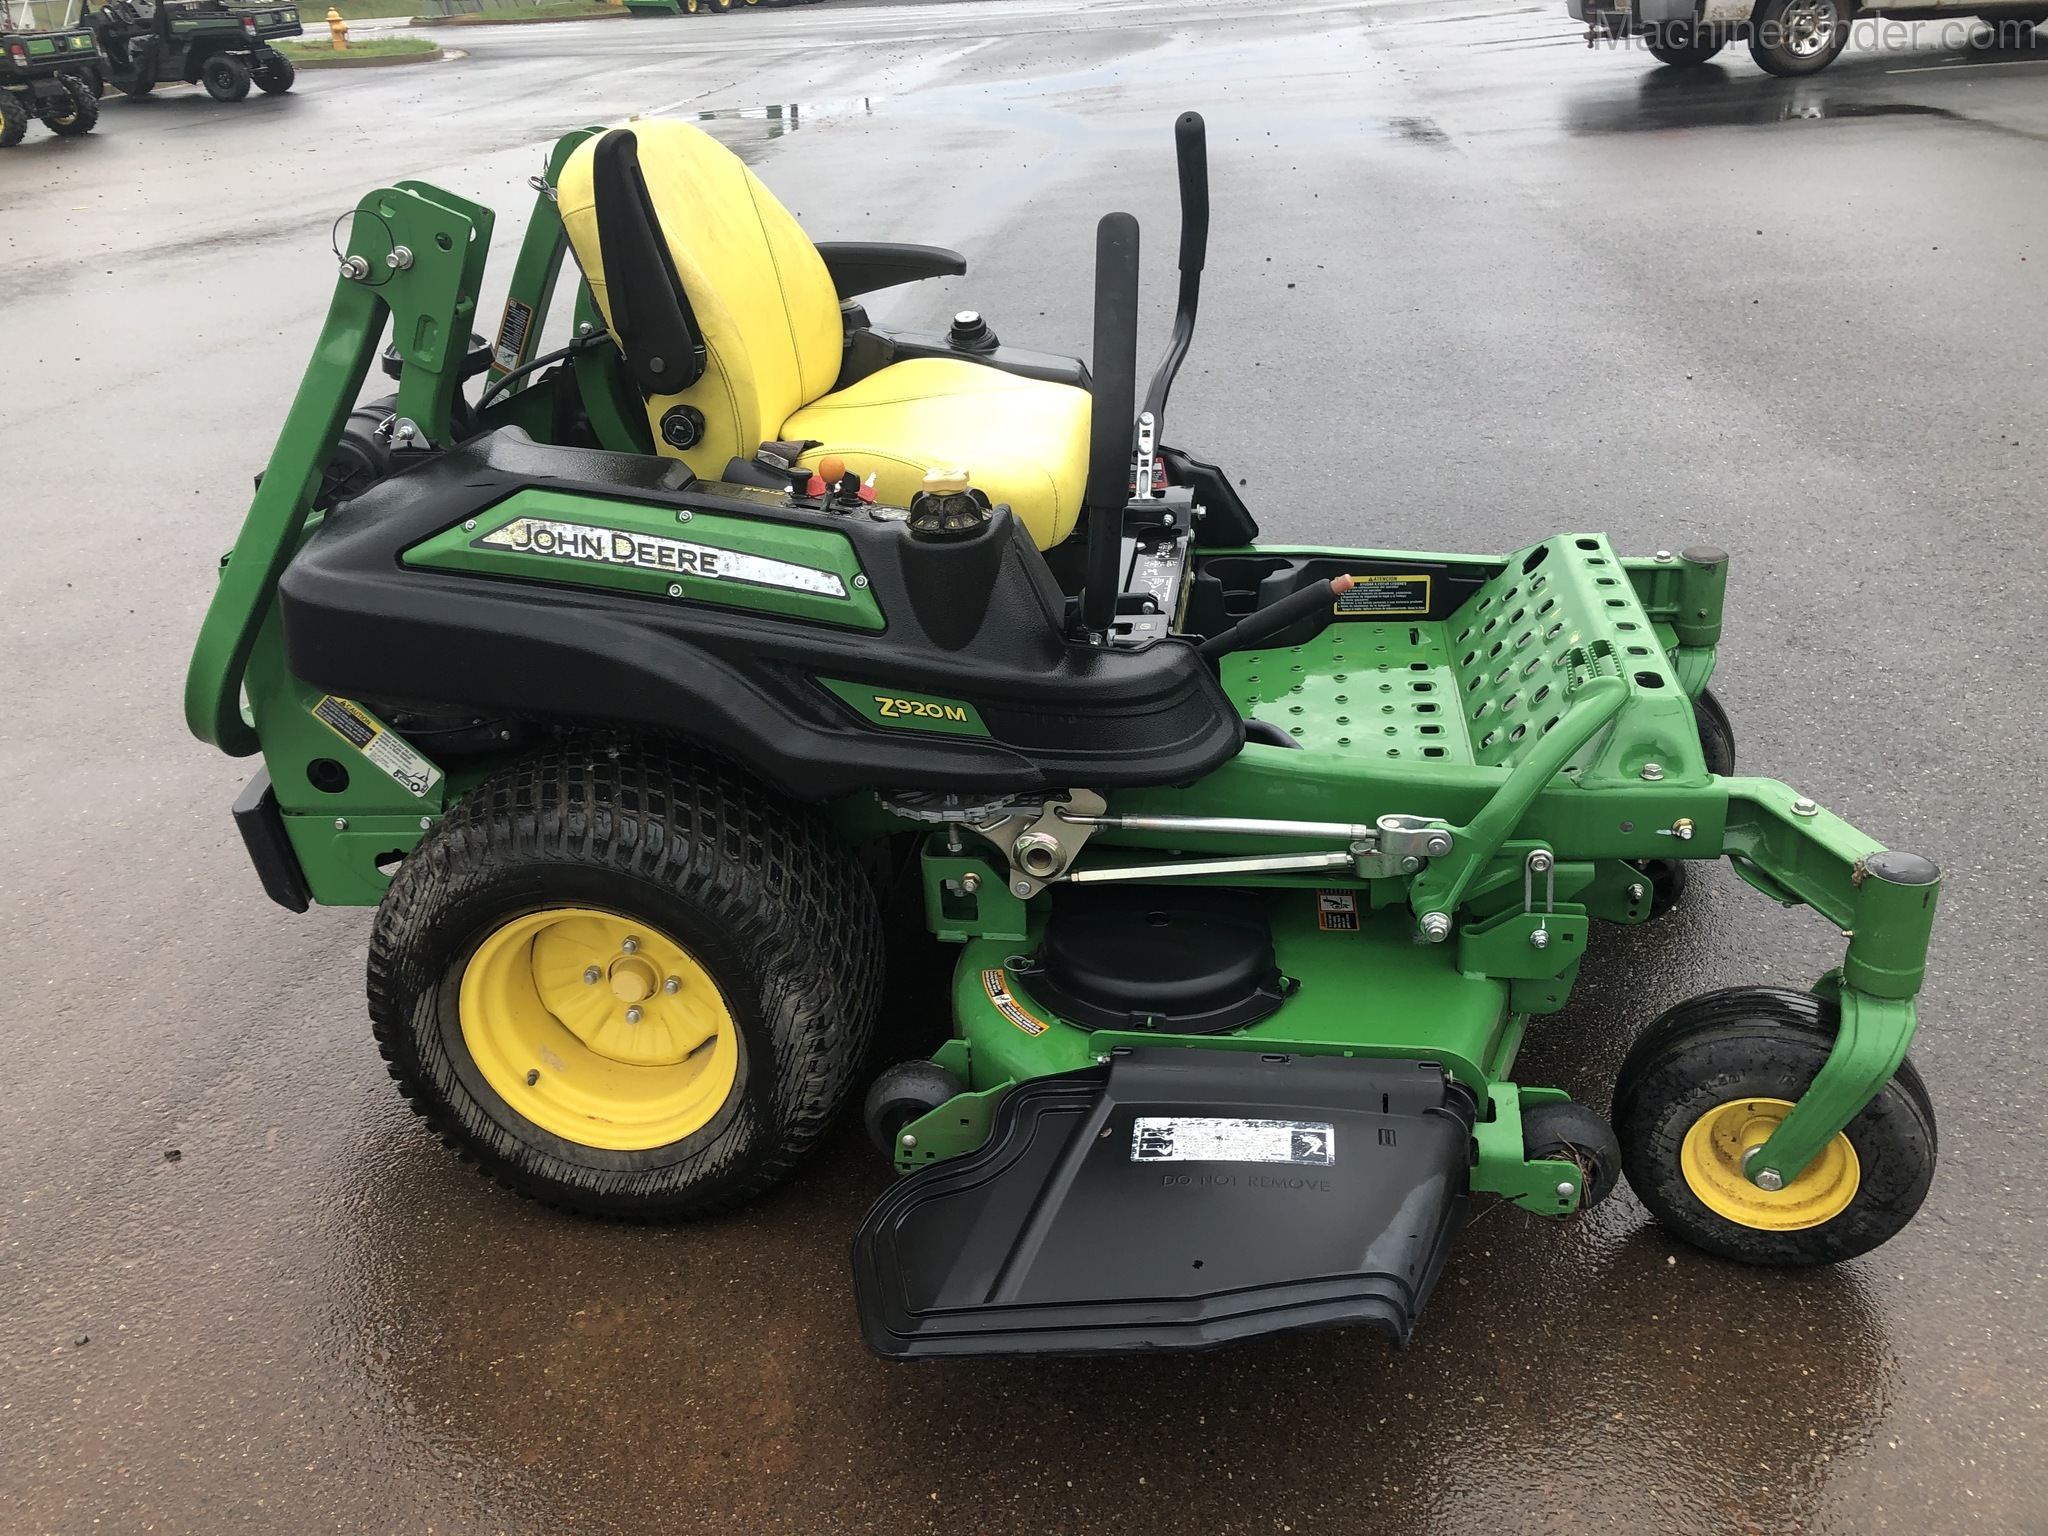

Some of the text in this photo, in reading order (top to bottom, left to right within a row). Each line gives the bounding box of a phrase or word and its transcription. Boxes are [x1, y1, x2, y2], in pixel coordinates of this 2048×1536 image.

[515, 523, 718, 574] JOHN DEERE
[345, 704, 372, 726] CAUTION
[874, 695, 968, 722] Z920M
[1162, 1174, 1331, 1193] DO NOT REMOVE
